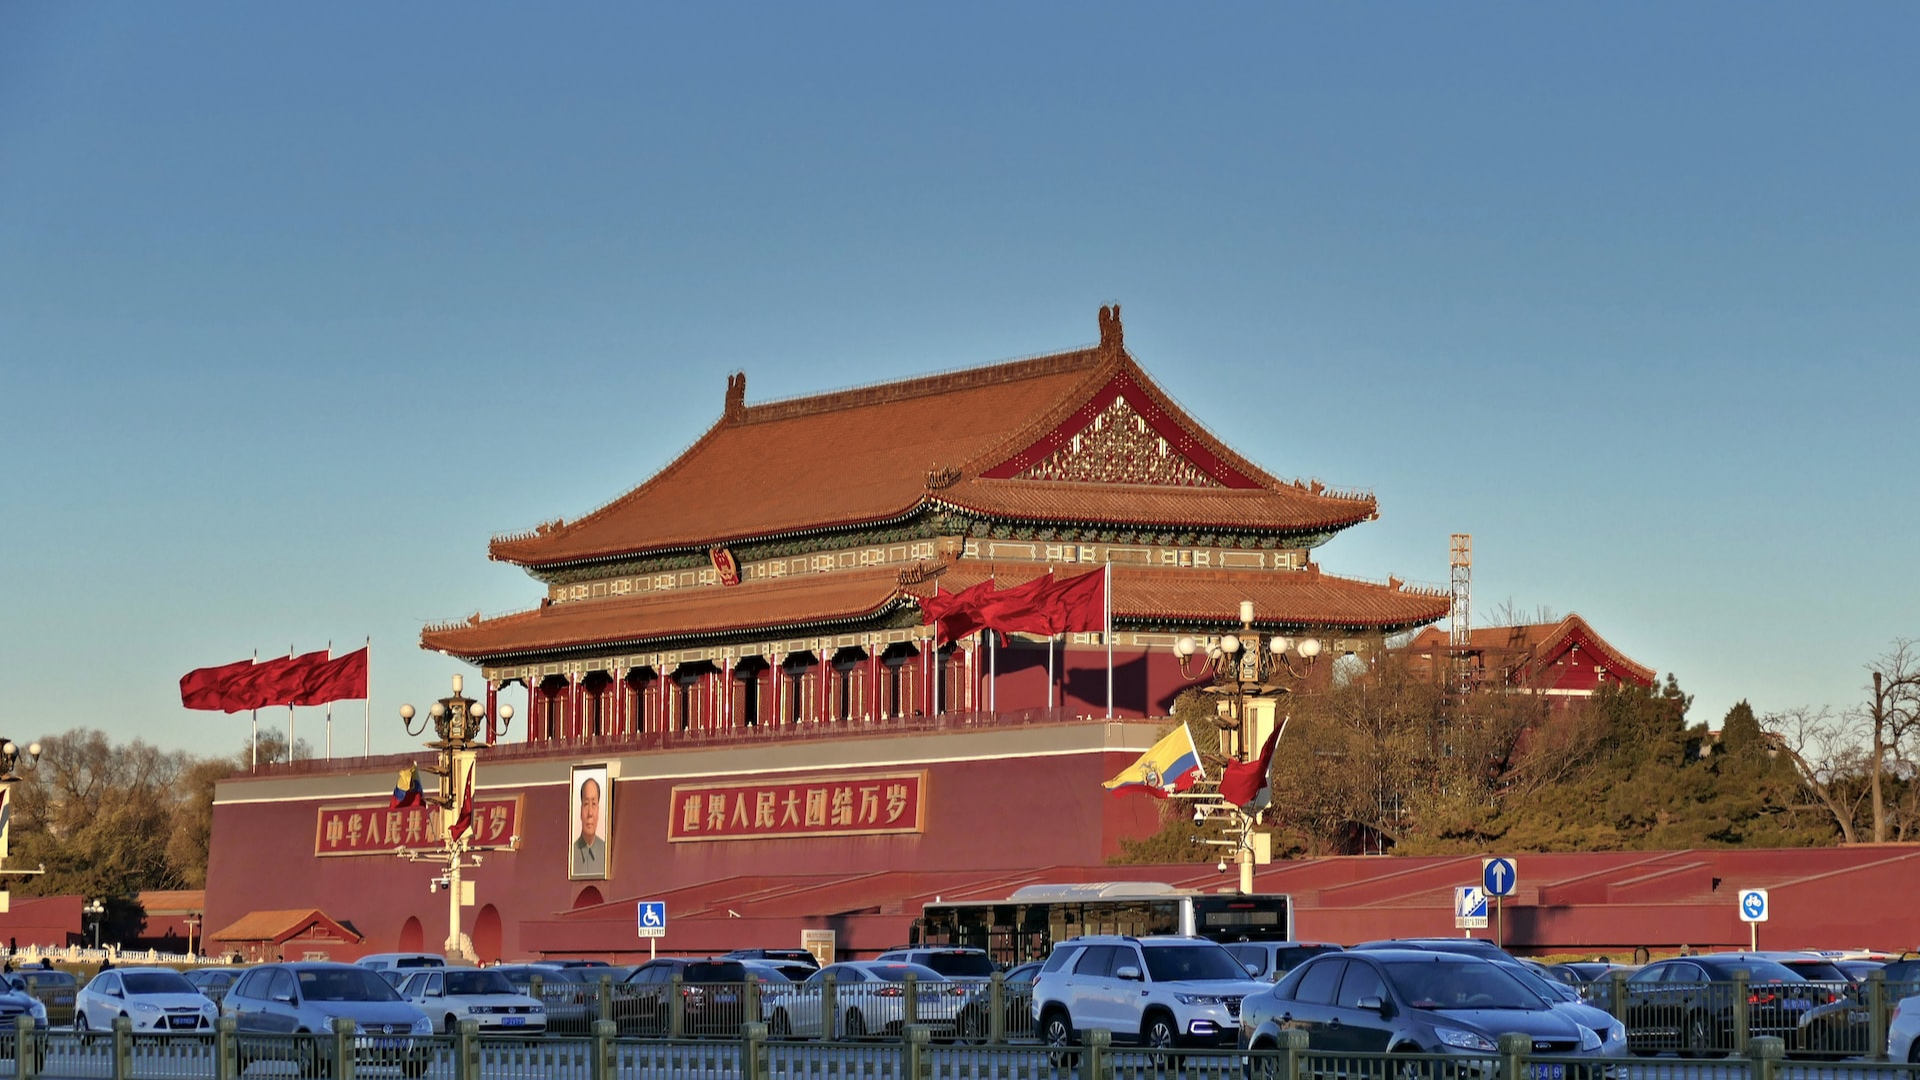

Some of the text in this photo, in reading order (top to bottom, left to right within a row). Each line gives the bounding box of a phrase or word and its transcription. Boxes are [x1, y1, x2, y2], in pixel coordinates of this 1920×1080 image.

[326, 805, 508, 847] 中华人民共和万岁
[683, 783, 908, 832] 世界人民大团结万岁
